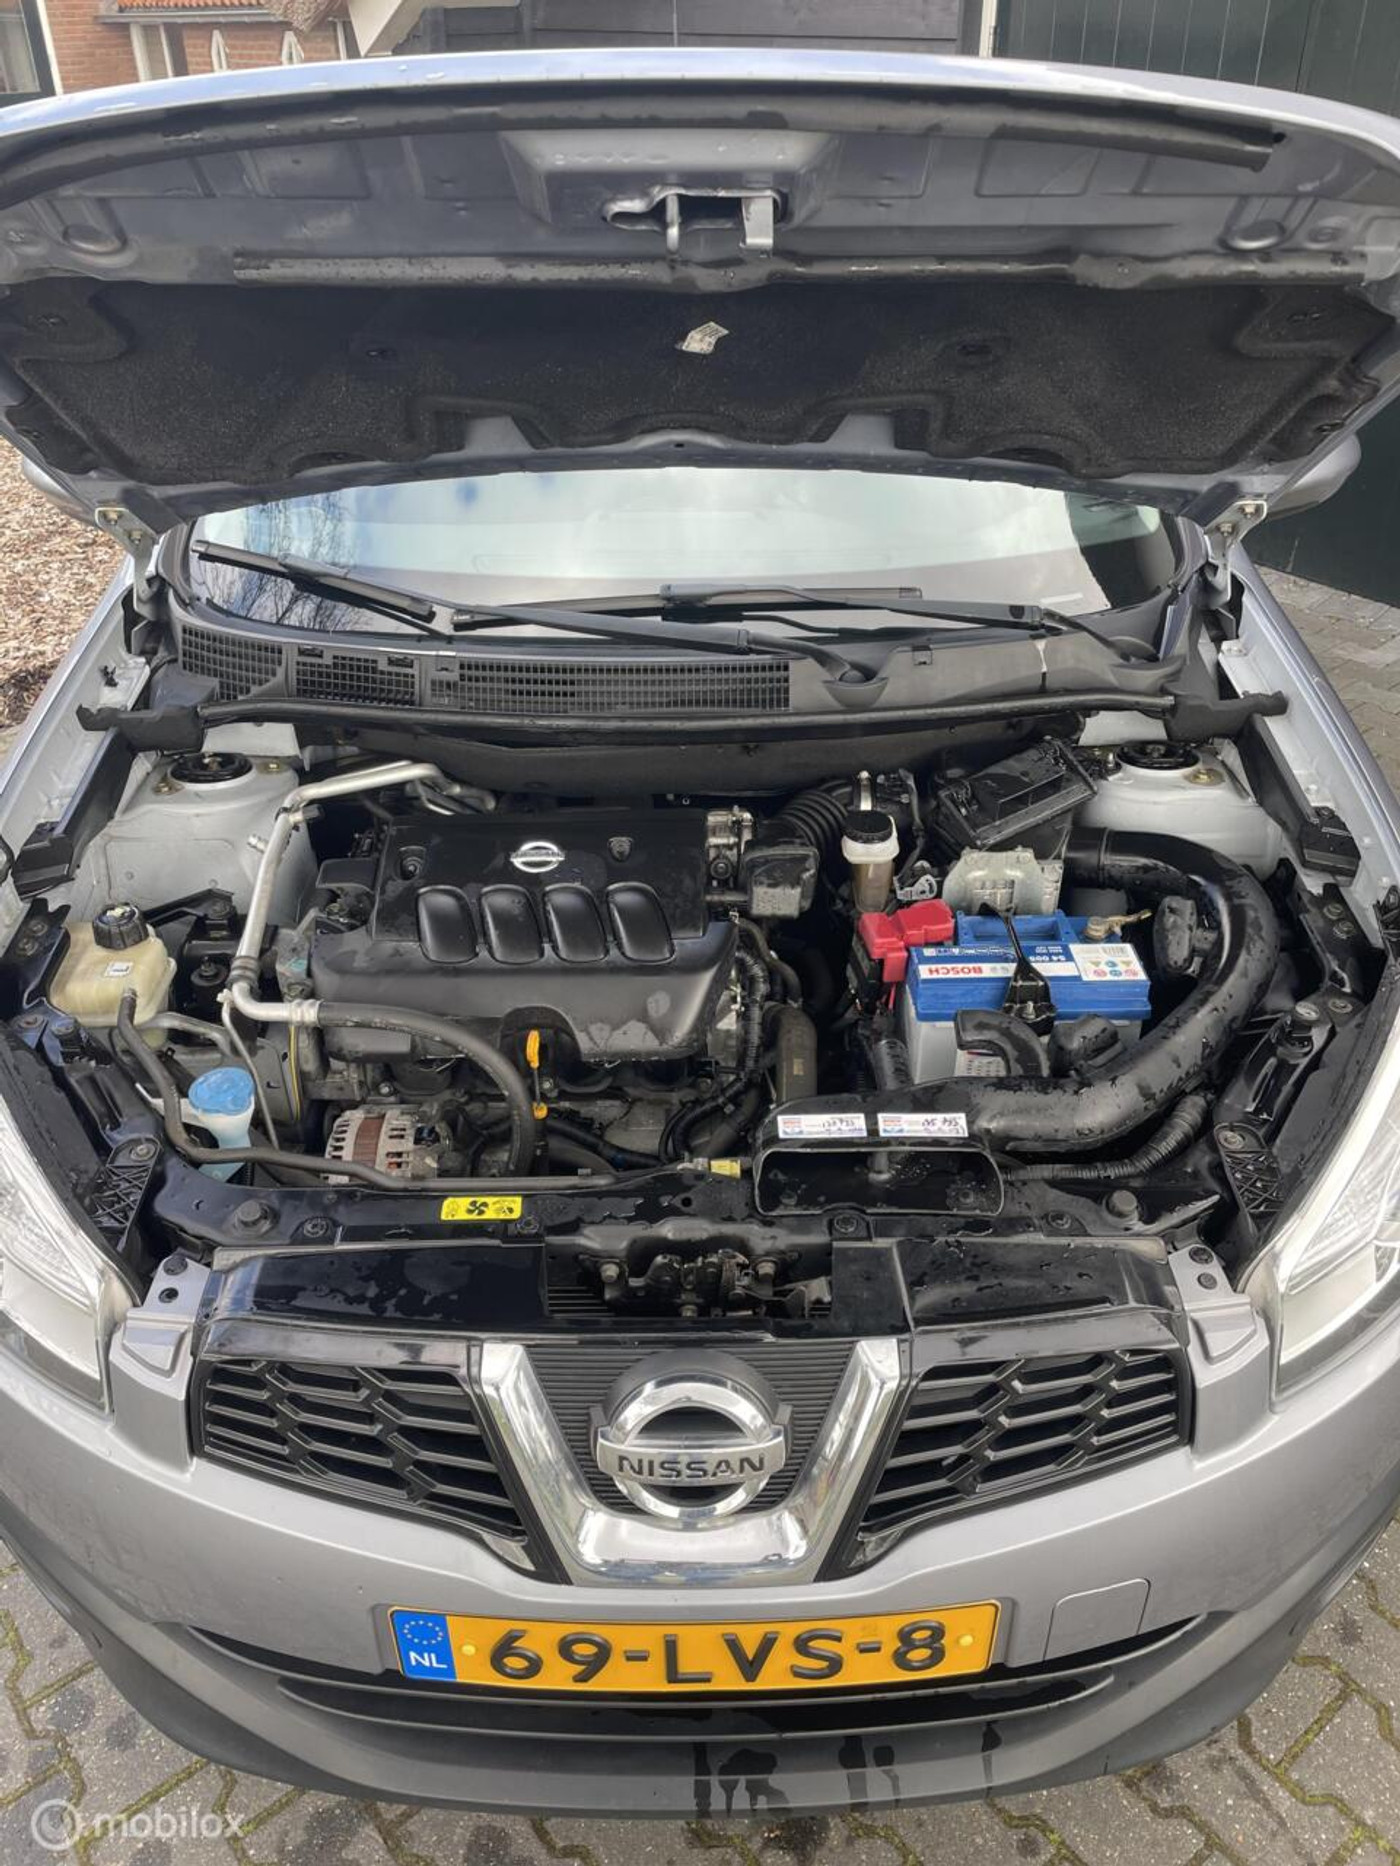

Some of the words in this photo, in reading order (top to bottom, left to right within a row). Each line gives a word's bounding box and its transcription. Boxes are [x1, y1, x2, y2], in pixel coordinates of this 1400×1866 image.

[928, 966, 983, 975] BOSCH
[617, 1454, 765, 1479] NISSAN
[408, 1650, 448, 1670] NL
[488, 1619, 947, 1685] 69-LVS-8
